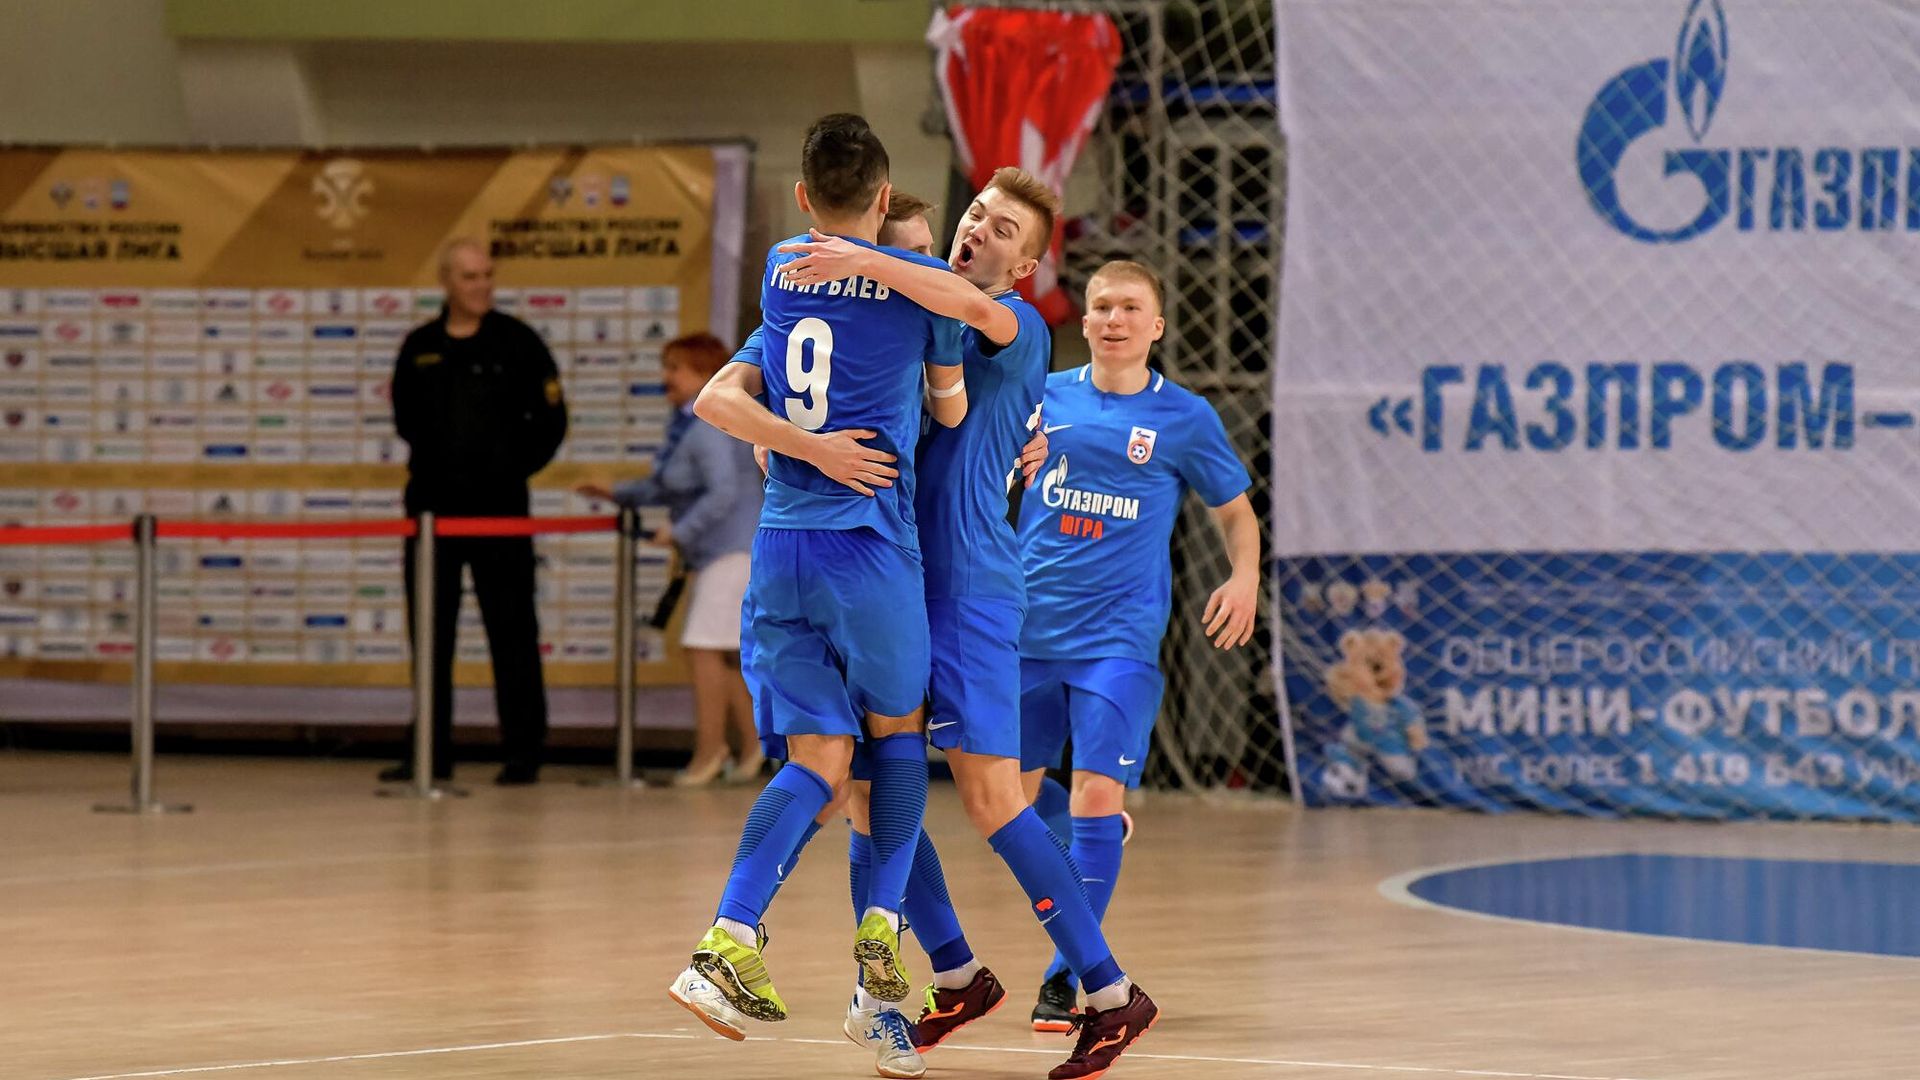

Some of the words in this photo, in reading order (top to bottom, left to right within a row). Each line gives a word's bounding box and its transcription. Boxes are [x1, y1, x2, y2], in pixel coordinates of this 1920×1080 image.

[0, 240, 108, 261] ЫСШАЯ
[116, 240, 180, 260] ЛИГА
[490, 238, 607, 258] ВЫСШАЯ
[614, 237, 679, 256] ЛИГА
[785, 317, 834, 430] 9
[1063, 488, 1140, 520] ГАЗПРОМ
[1060, 514, 1103, 539] ЮГРА
[1441, 633, 1872, 682] ОБЩЕРОССИЙСКИЙ
[1443, 685, 1920, 741] МИНИ-ФУТБОЛ
[1637, 753, 1656, 784] 1
